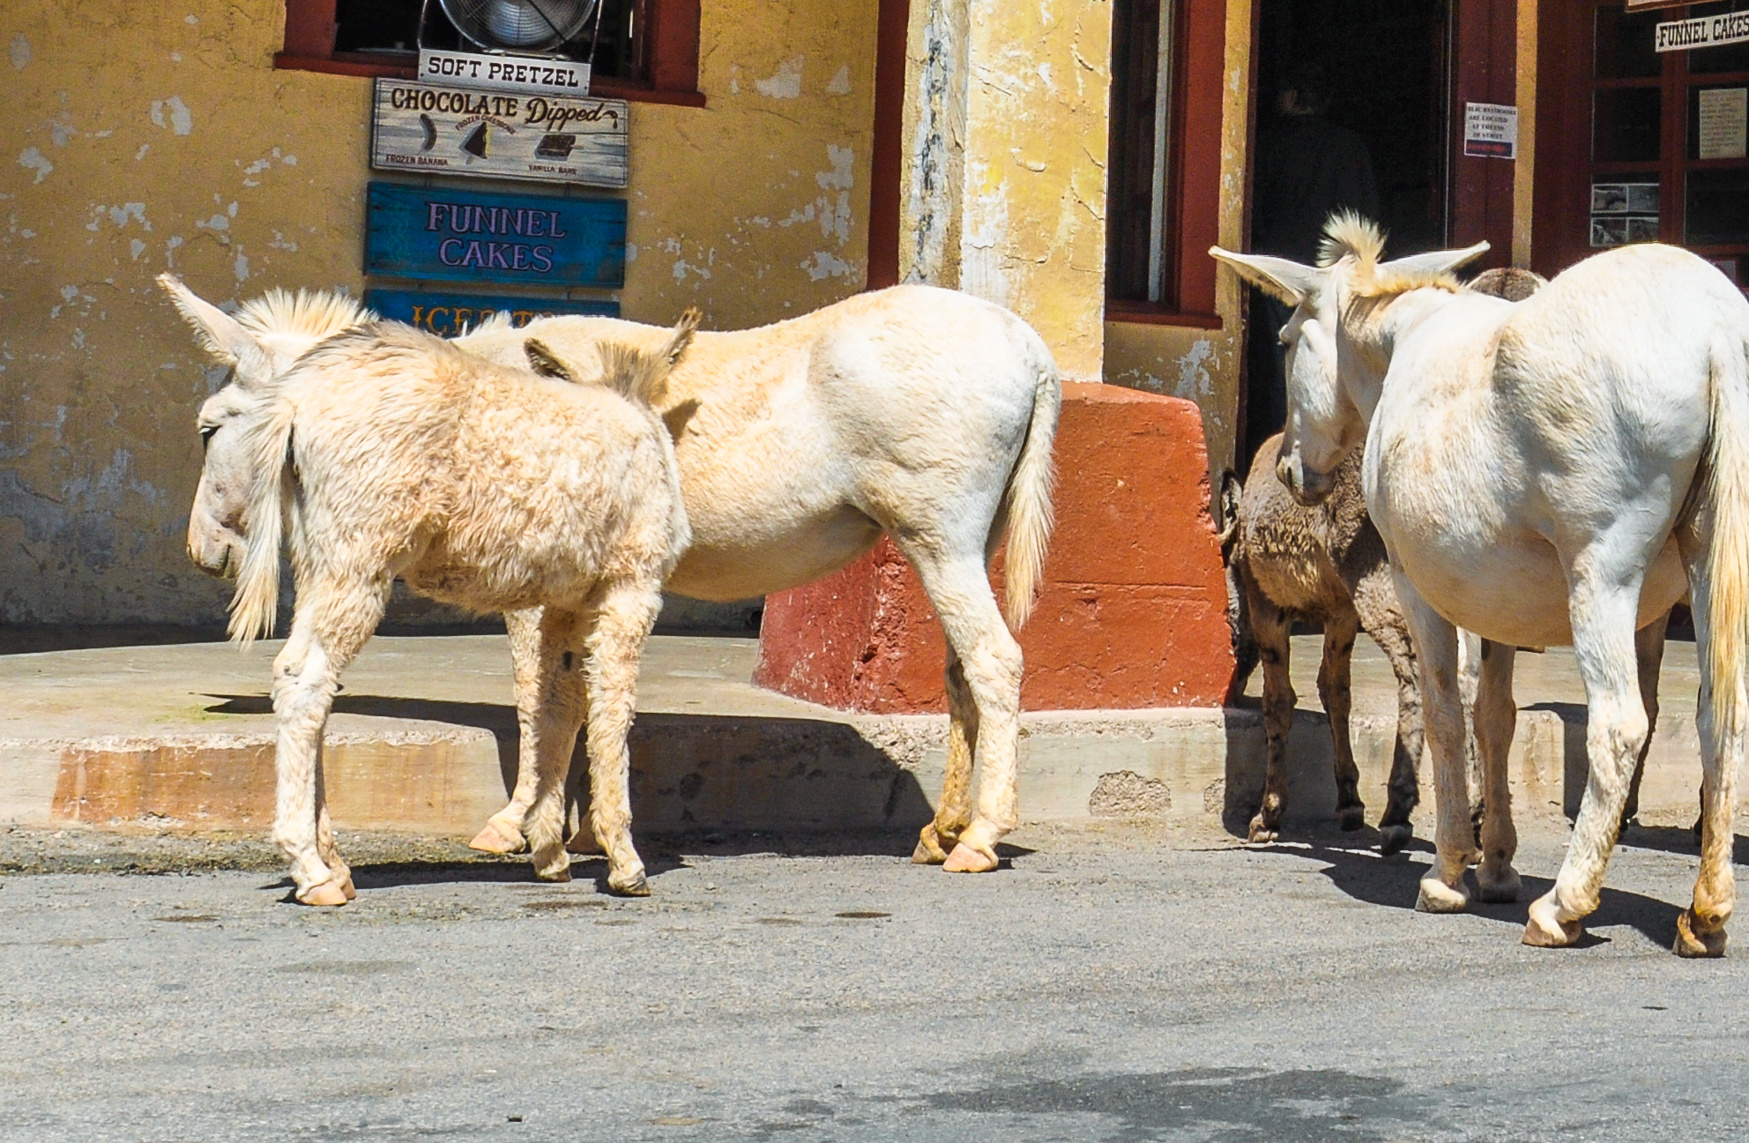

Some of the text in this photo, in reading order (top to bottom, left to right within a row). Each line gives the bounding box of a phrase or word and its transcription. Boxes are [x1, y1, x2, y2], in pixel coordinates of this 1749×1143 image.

[1659, 21, 1708, 47] FUNNEL
[428, 56, 579, 87] SOFT PRETZEL
[390, 88, 606, 132] CHOCOLATE Dipped
[426, 202, 567, 238] FUNNEL
[438, 238, 554, 273] CAKES
